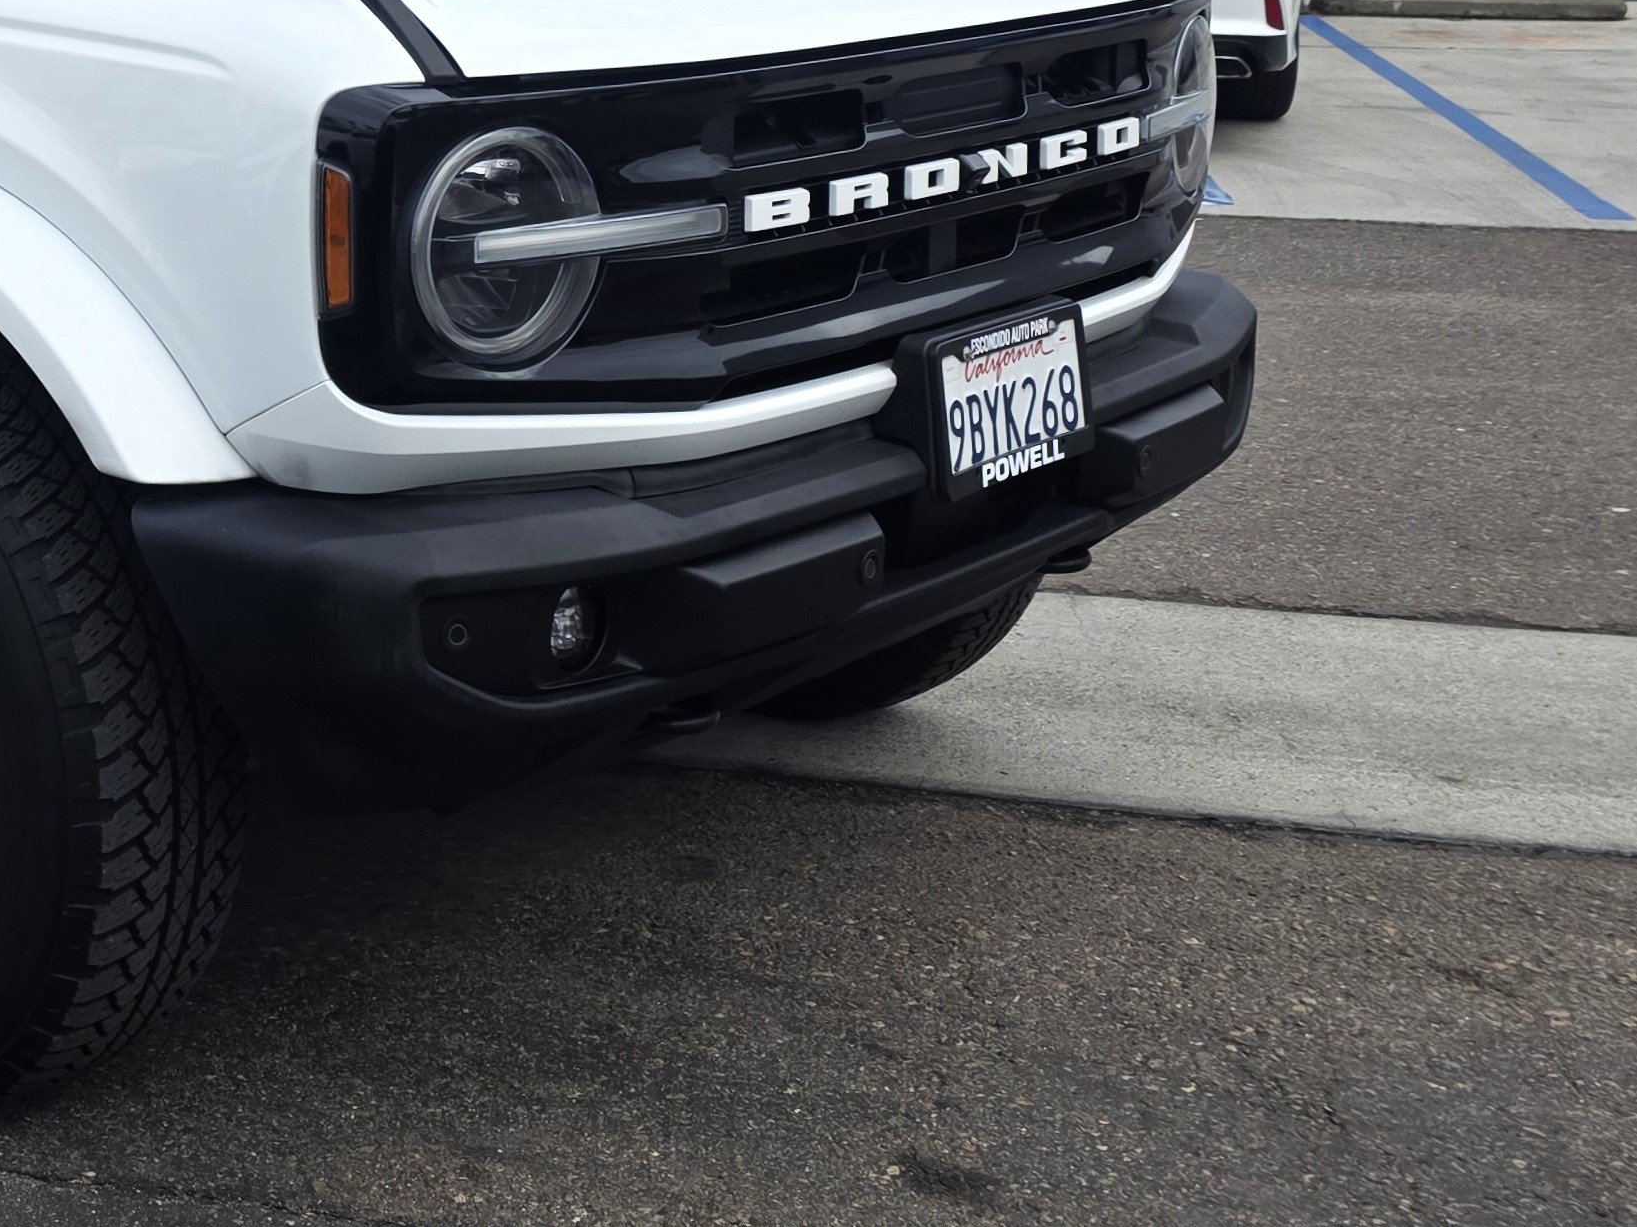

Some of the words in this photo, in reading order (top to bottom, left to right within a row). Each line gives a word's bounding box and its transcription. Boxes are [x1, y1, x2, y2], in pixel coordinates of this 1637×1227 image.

[744, 116, 1140, 233] BRONCO
[964, 339, 1054, 383] California
[970, 328, 1010, 358] ESCONDIDO
[1011, 322, 1029, 344] AUTO
[1031, 317, 1050, 338] PARK
[950, 365, 1078, 472] 9BYK268
[982, 439, 1065, 488] POWELL
